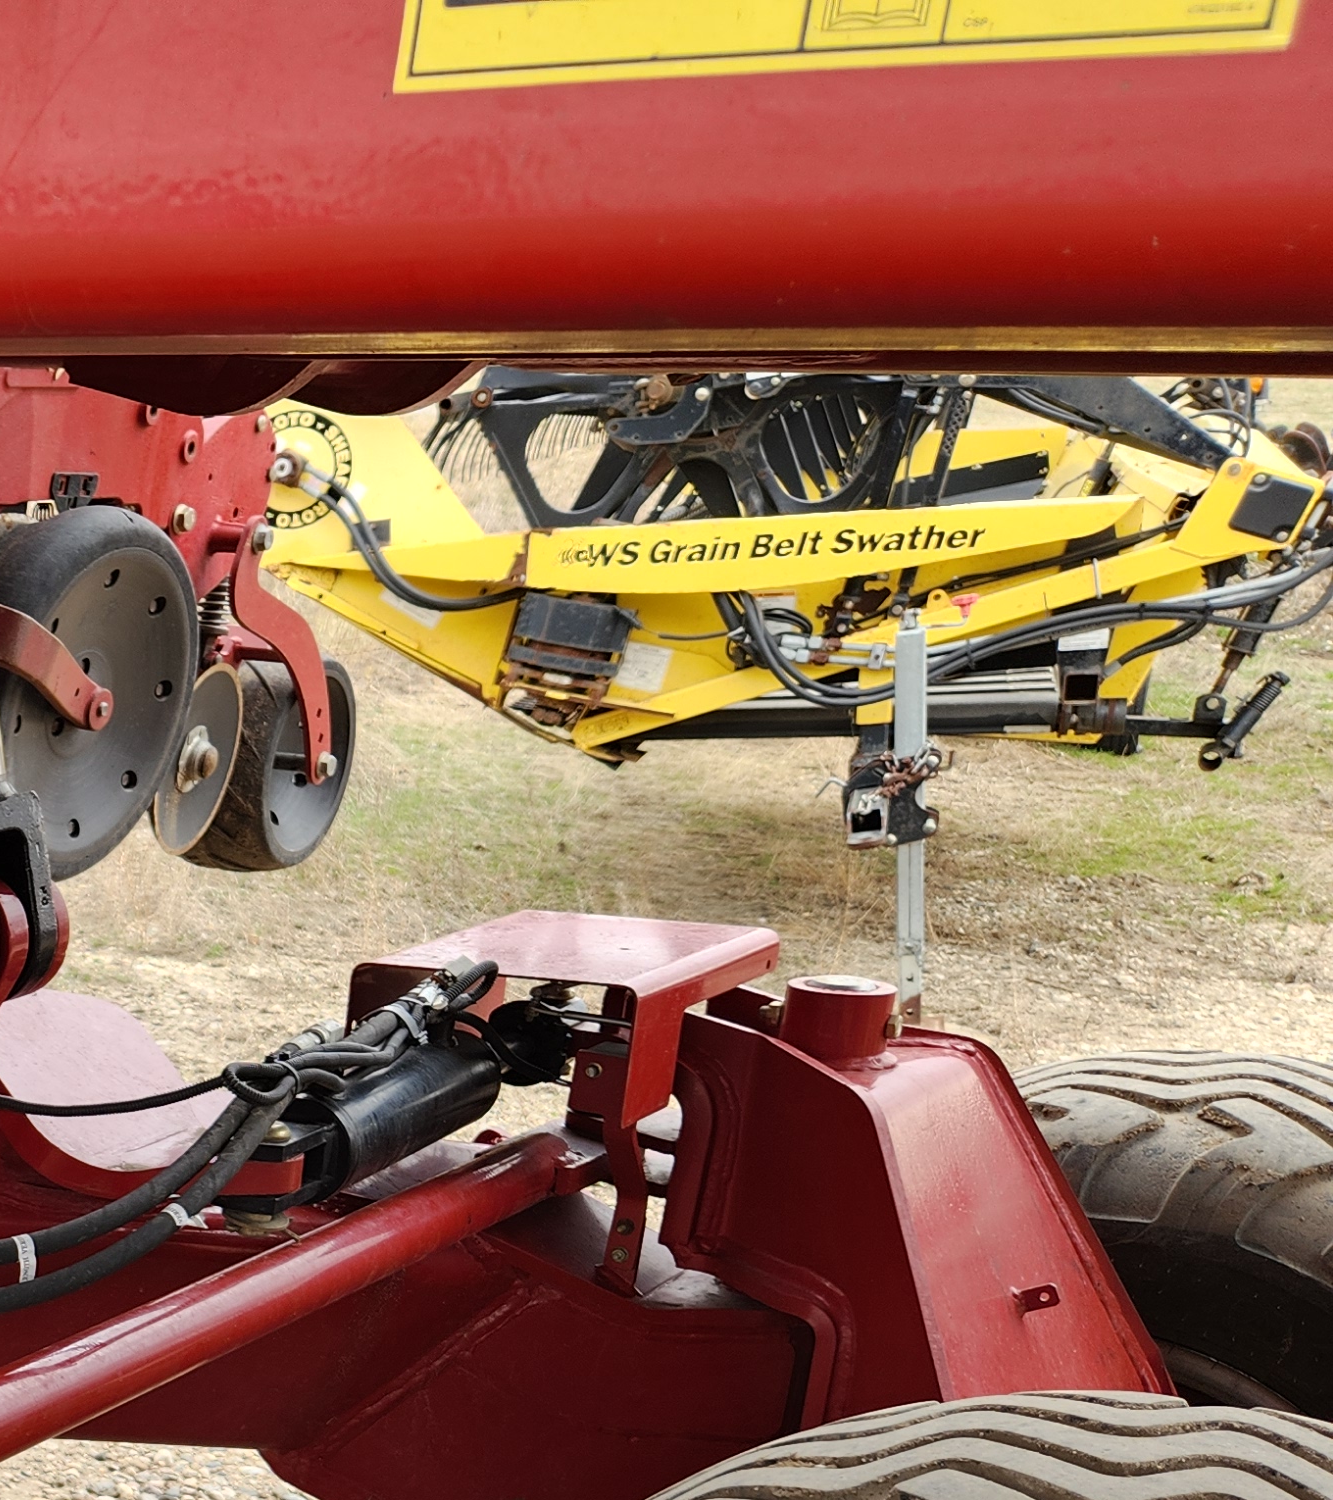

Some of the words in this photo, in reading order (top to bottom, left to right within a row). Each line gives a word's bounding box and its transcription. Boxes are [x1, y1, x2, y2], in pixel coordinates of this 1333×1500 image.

[271, 410, 316, 430] OTO
[649, 536, 741, 564] Grain
[749, 531, 823, 558] Belt
[829, 524, 987, 554] Swather
